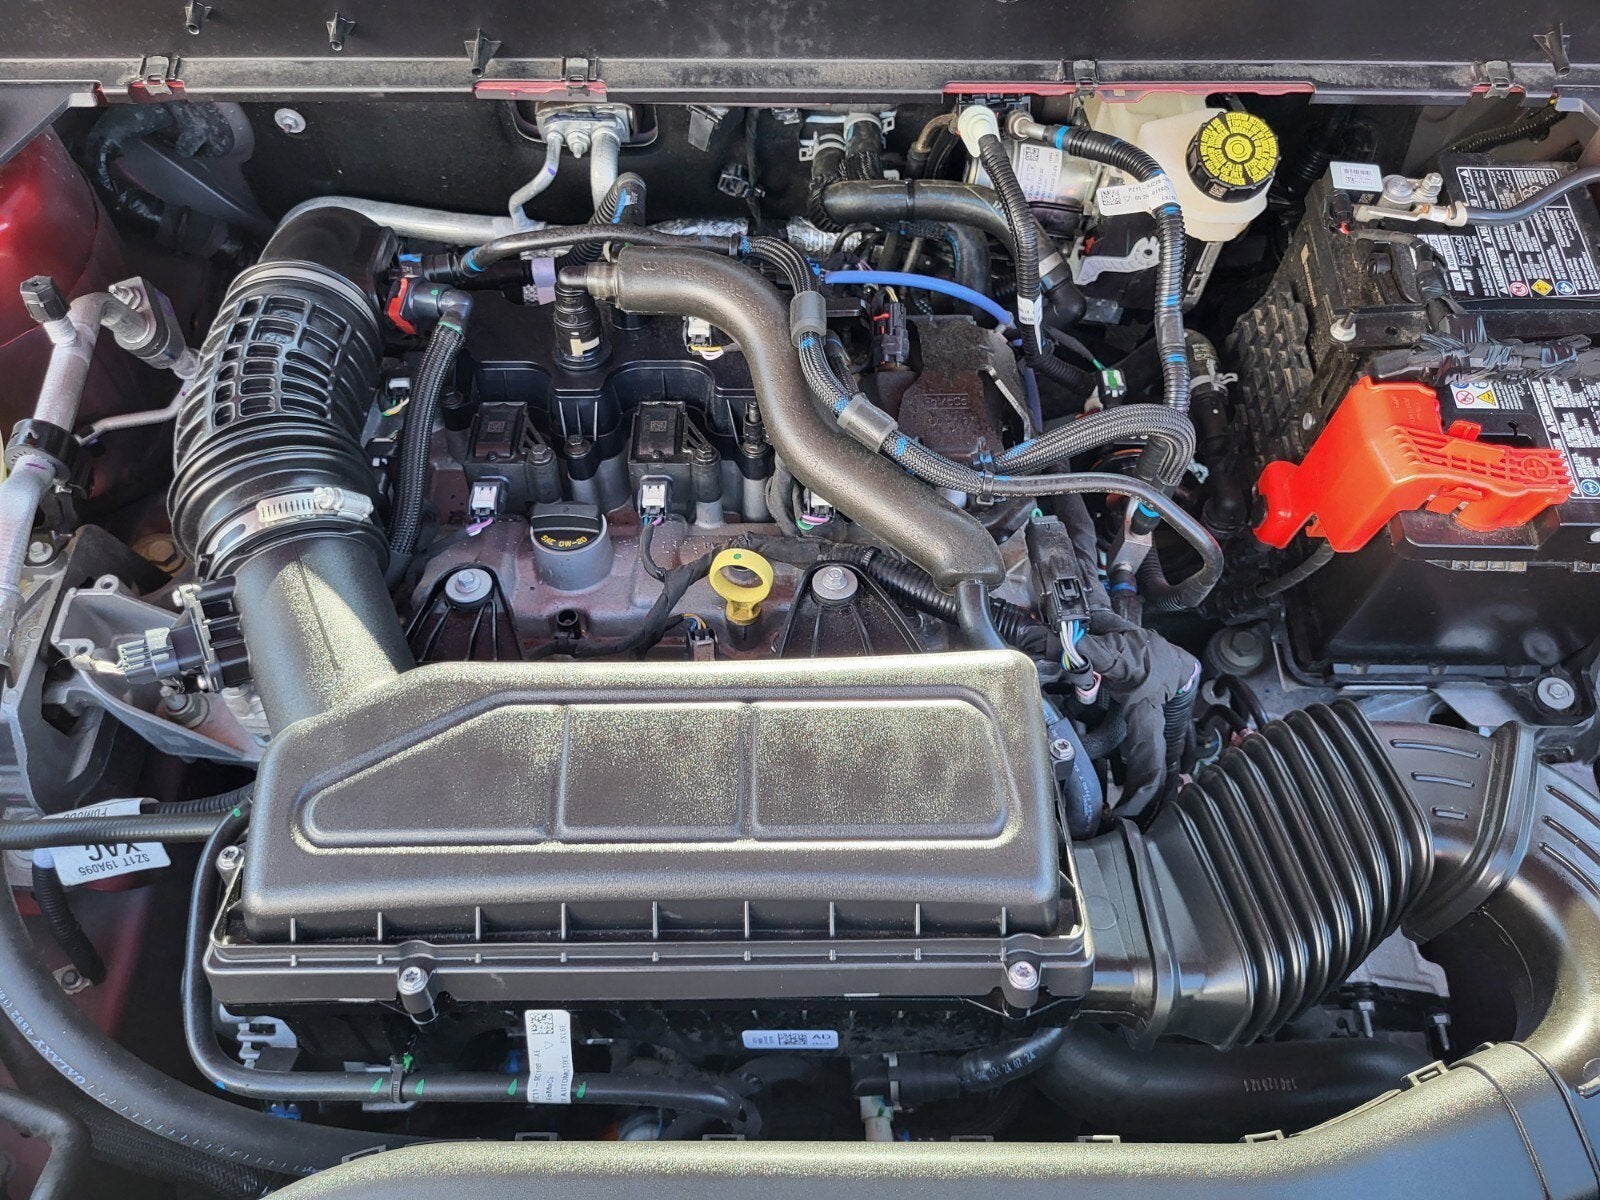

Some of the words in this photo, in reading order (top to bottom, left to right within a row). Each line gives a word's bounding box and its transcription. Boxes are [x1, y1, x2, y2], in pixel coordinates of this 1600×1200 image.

[1455, 237, 1468, 265] FoMoCo
[541, 534, 556, 546] SAE
[558, 536, 588, 547] 0W-20
[78, 859, 119, 876] 19A095
[33, 1039, 86, 1084] GALAXY
